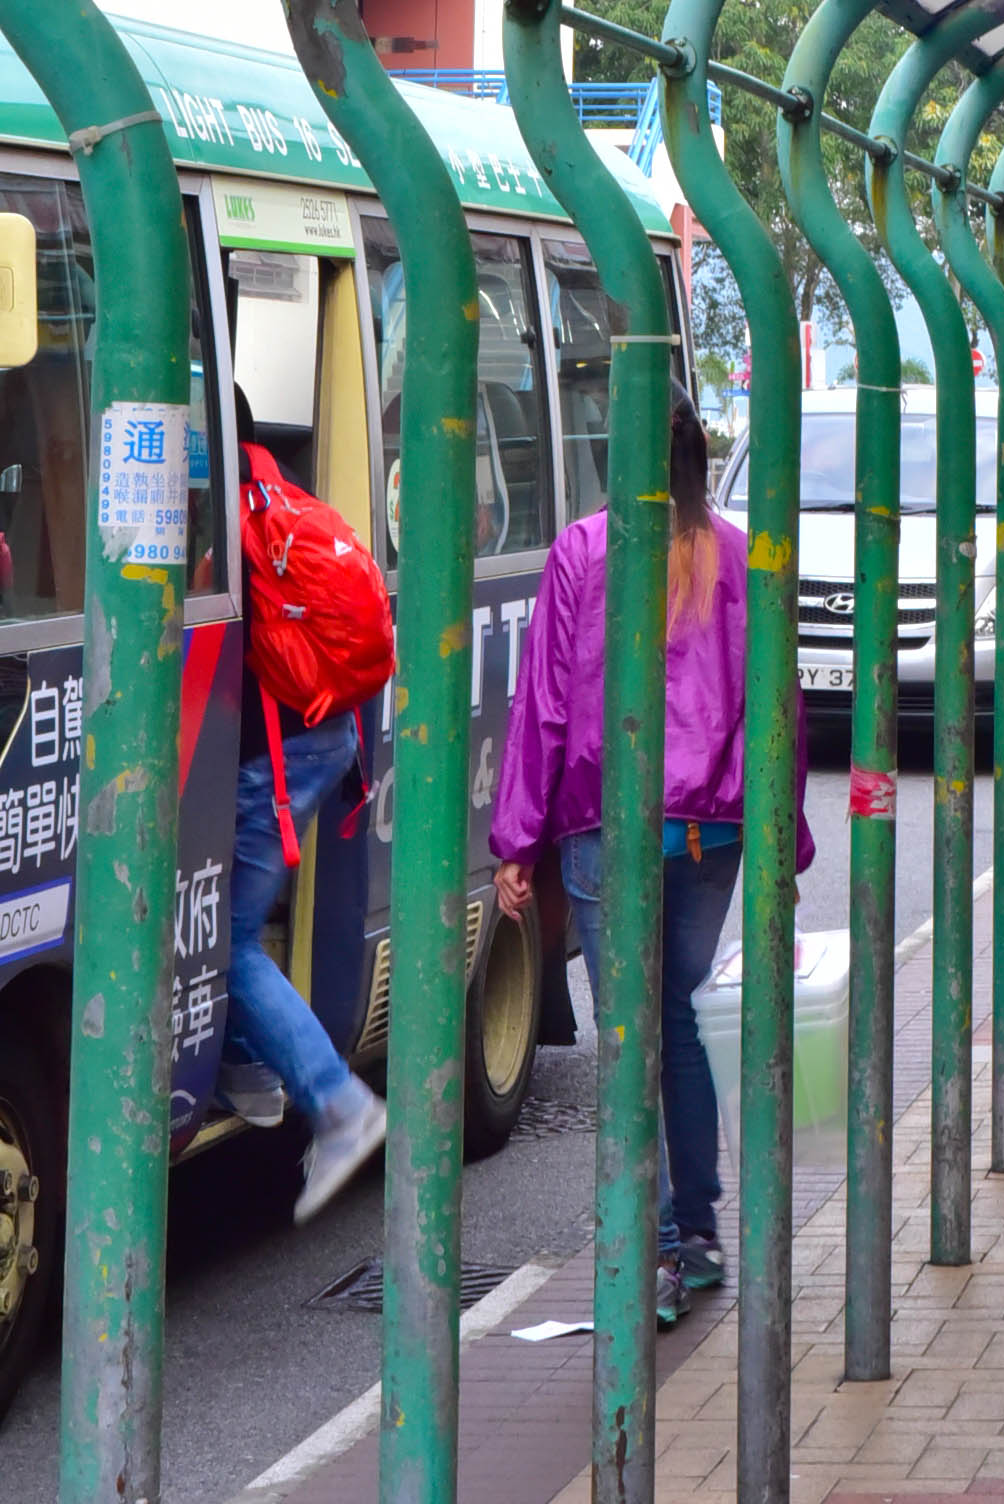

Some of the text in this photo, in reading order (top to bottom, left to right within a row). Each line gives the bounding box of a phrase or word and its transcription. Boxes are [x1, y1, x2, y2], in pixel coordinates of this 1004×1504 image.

[160, 88, 234, 146] LIGHT
[237, 104, 288, 157] BUS
[293, 116, 322, 163] 16
[224, 194, 256, 222] LUKES
[123, 420, 187, 464] 通
